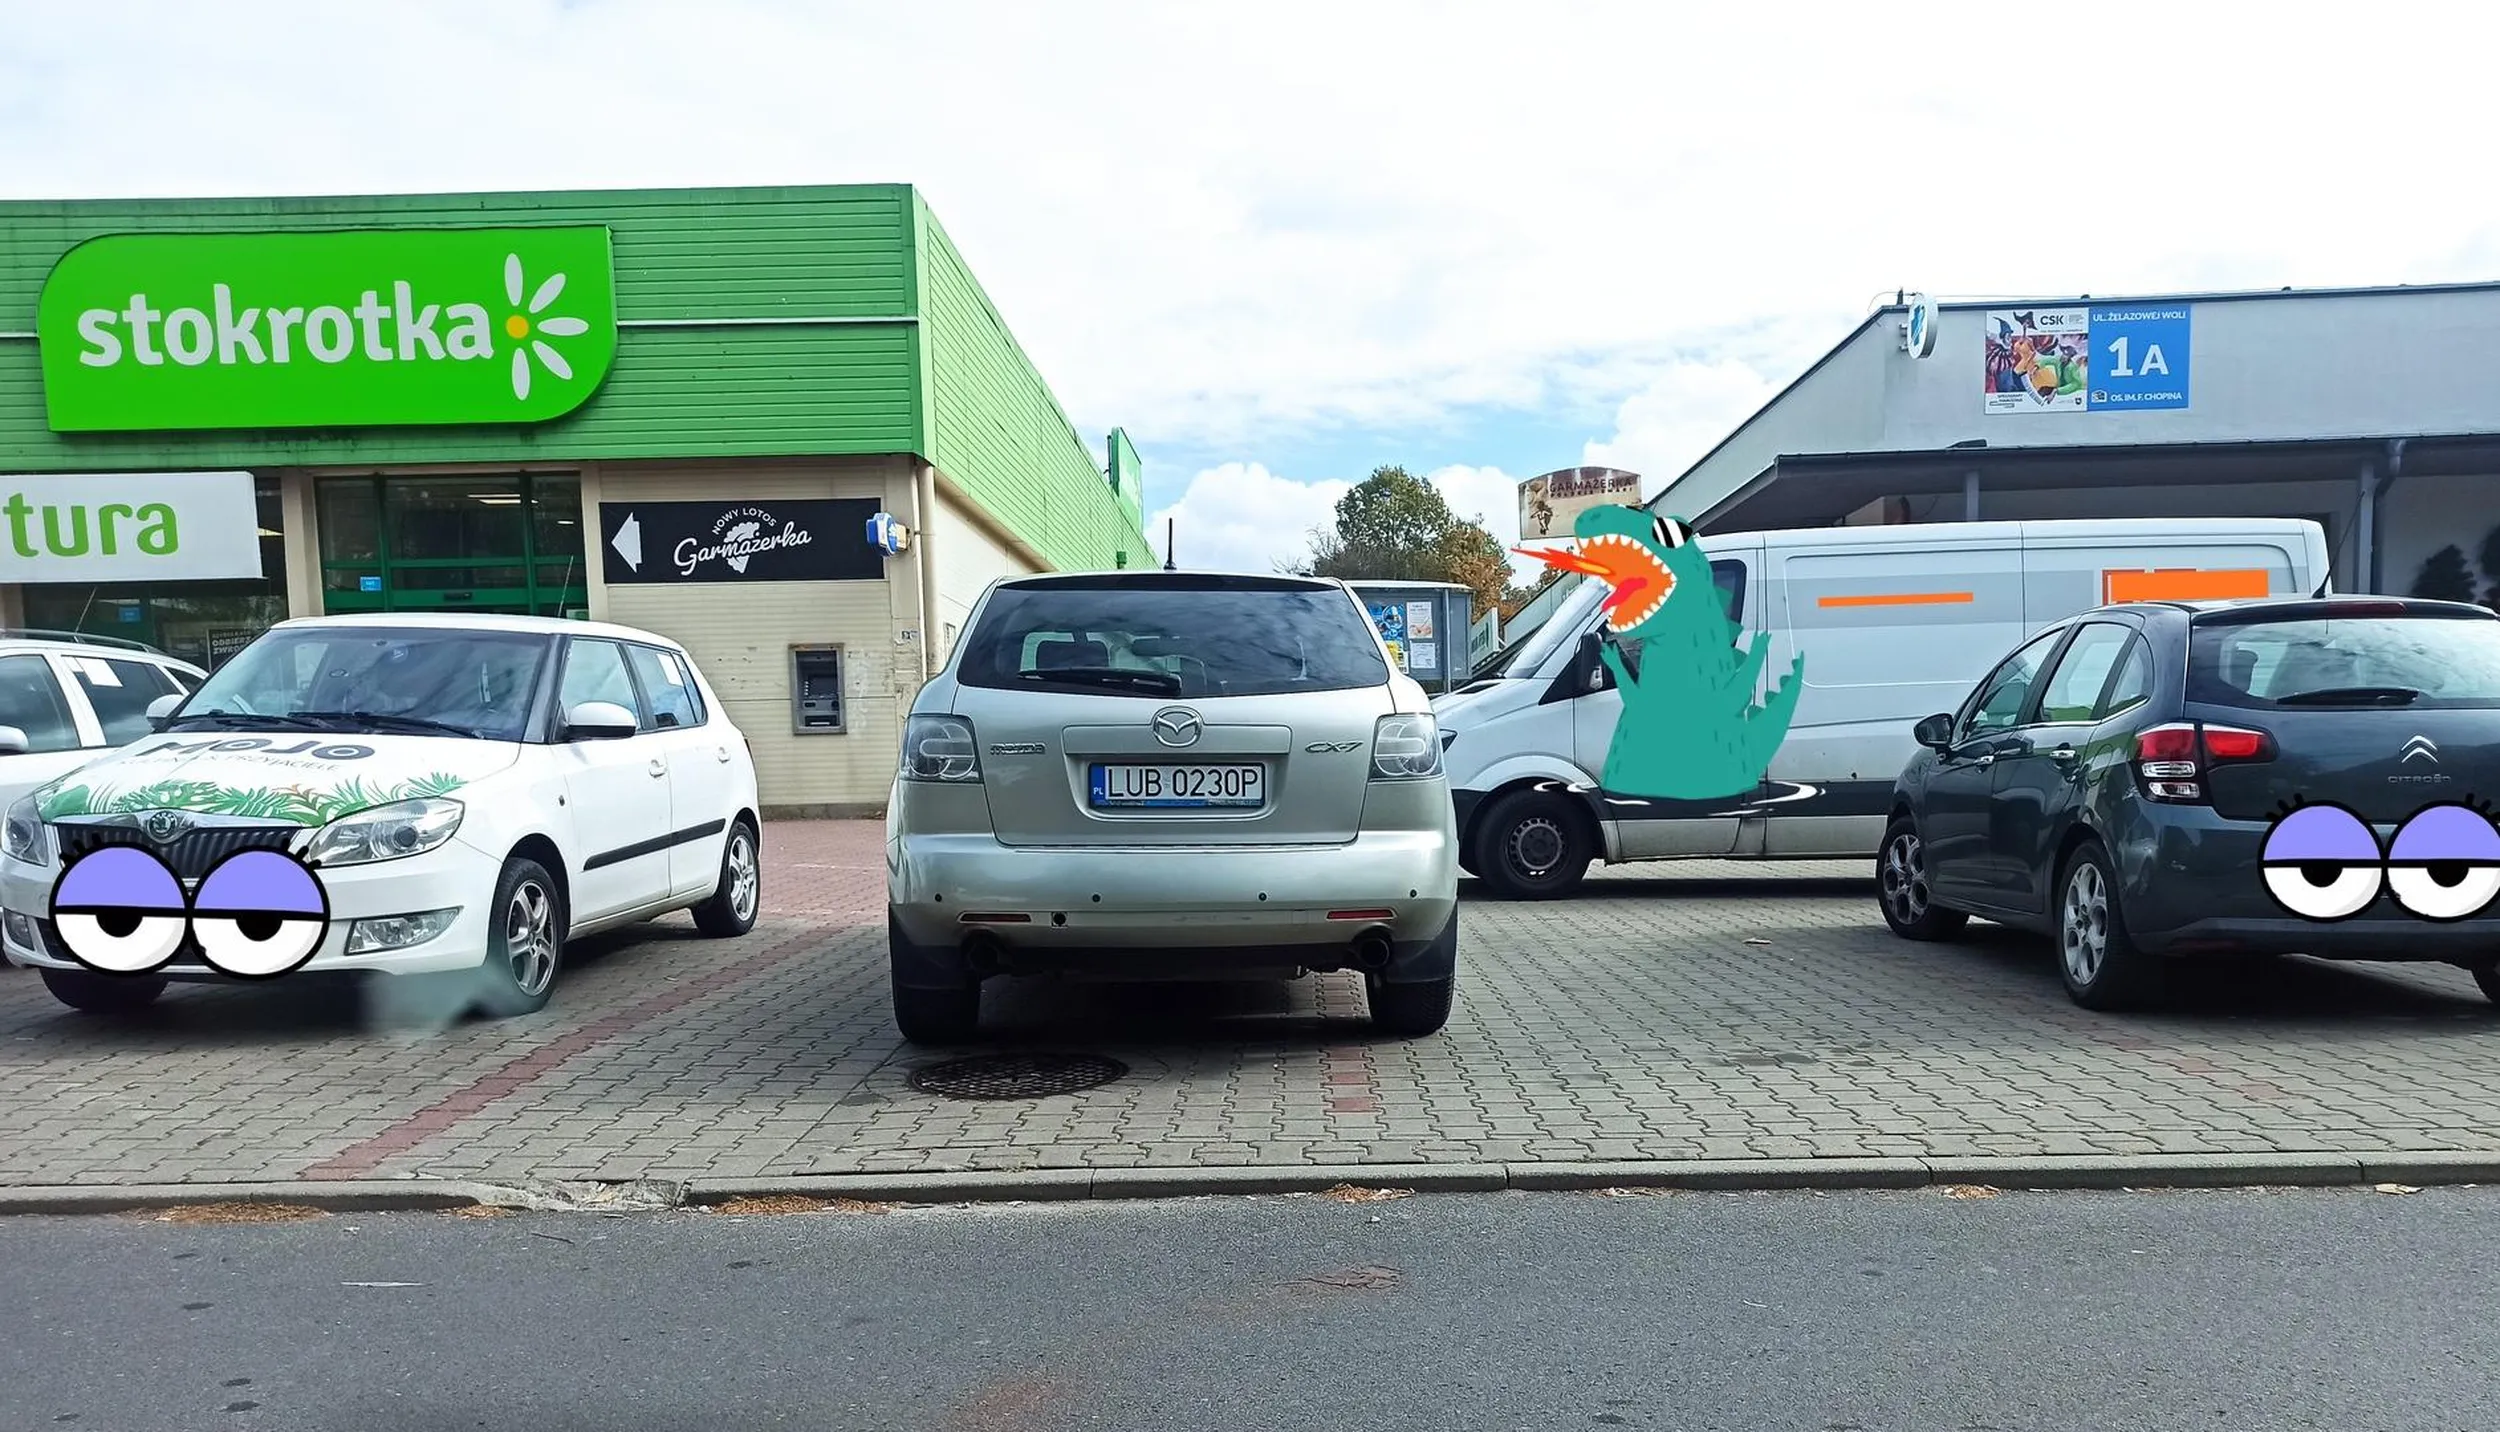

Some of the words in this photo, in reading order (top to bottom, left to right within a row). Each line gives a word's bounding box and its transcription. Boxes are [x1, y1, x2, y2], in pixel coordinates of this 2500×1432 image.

[77, 280, 494, 367] stokrotka
[2040, 315, 2064, 326] CSK
[2162, 310, 2186, 319] WOLI
[2144, 391, 2183, 401] CHOPINA
[3, 492, 179, 557] tura
[712, 508, 739, 535] NOWY
[743, 507, 777, 527] LOTOS
[673, 520, 813, 576] Garmażerka
[135, 738, 376, 760] MOJO
[1305, 740, 1364, 754] CX-7
[1093, 786, 1104, 796] PL
[1107, 769, 1162, 797] LUB
[1172, 768, 1258, 798] 0230P
